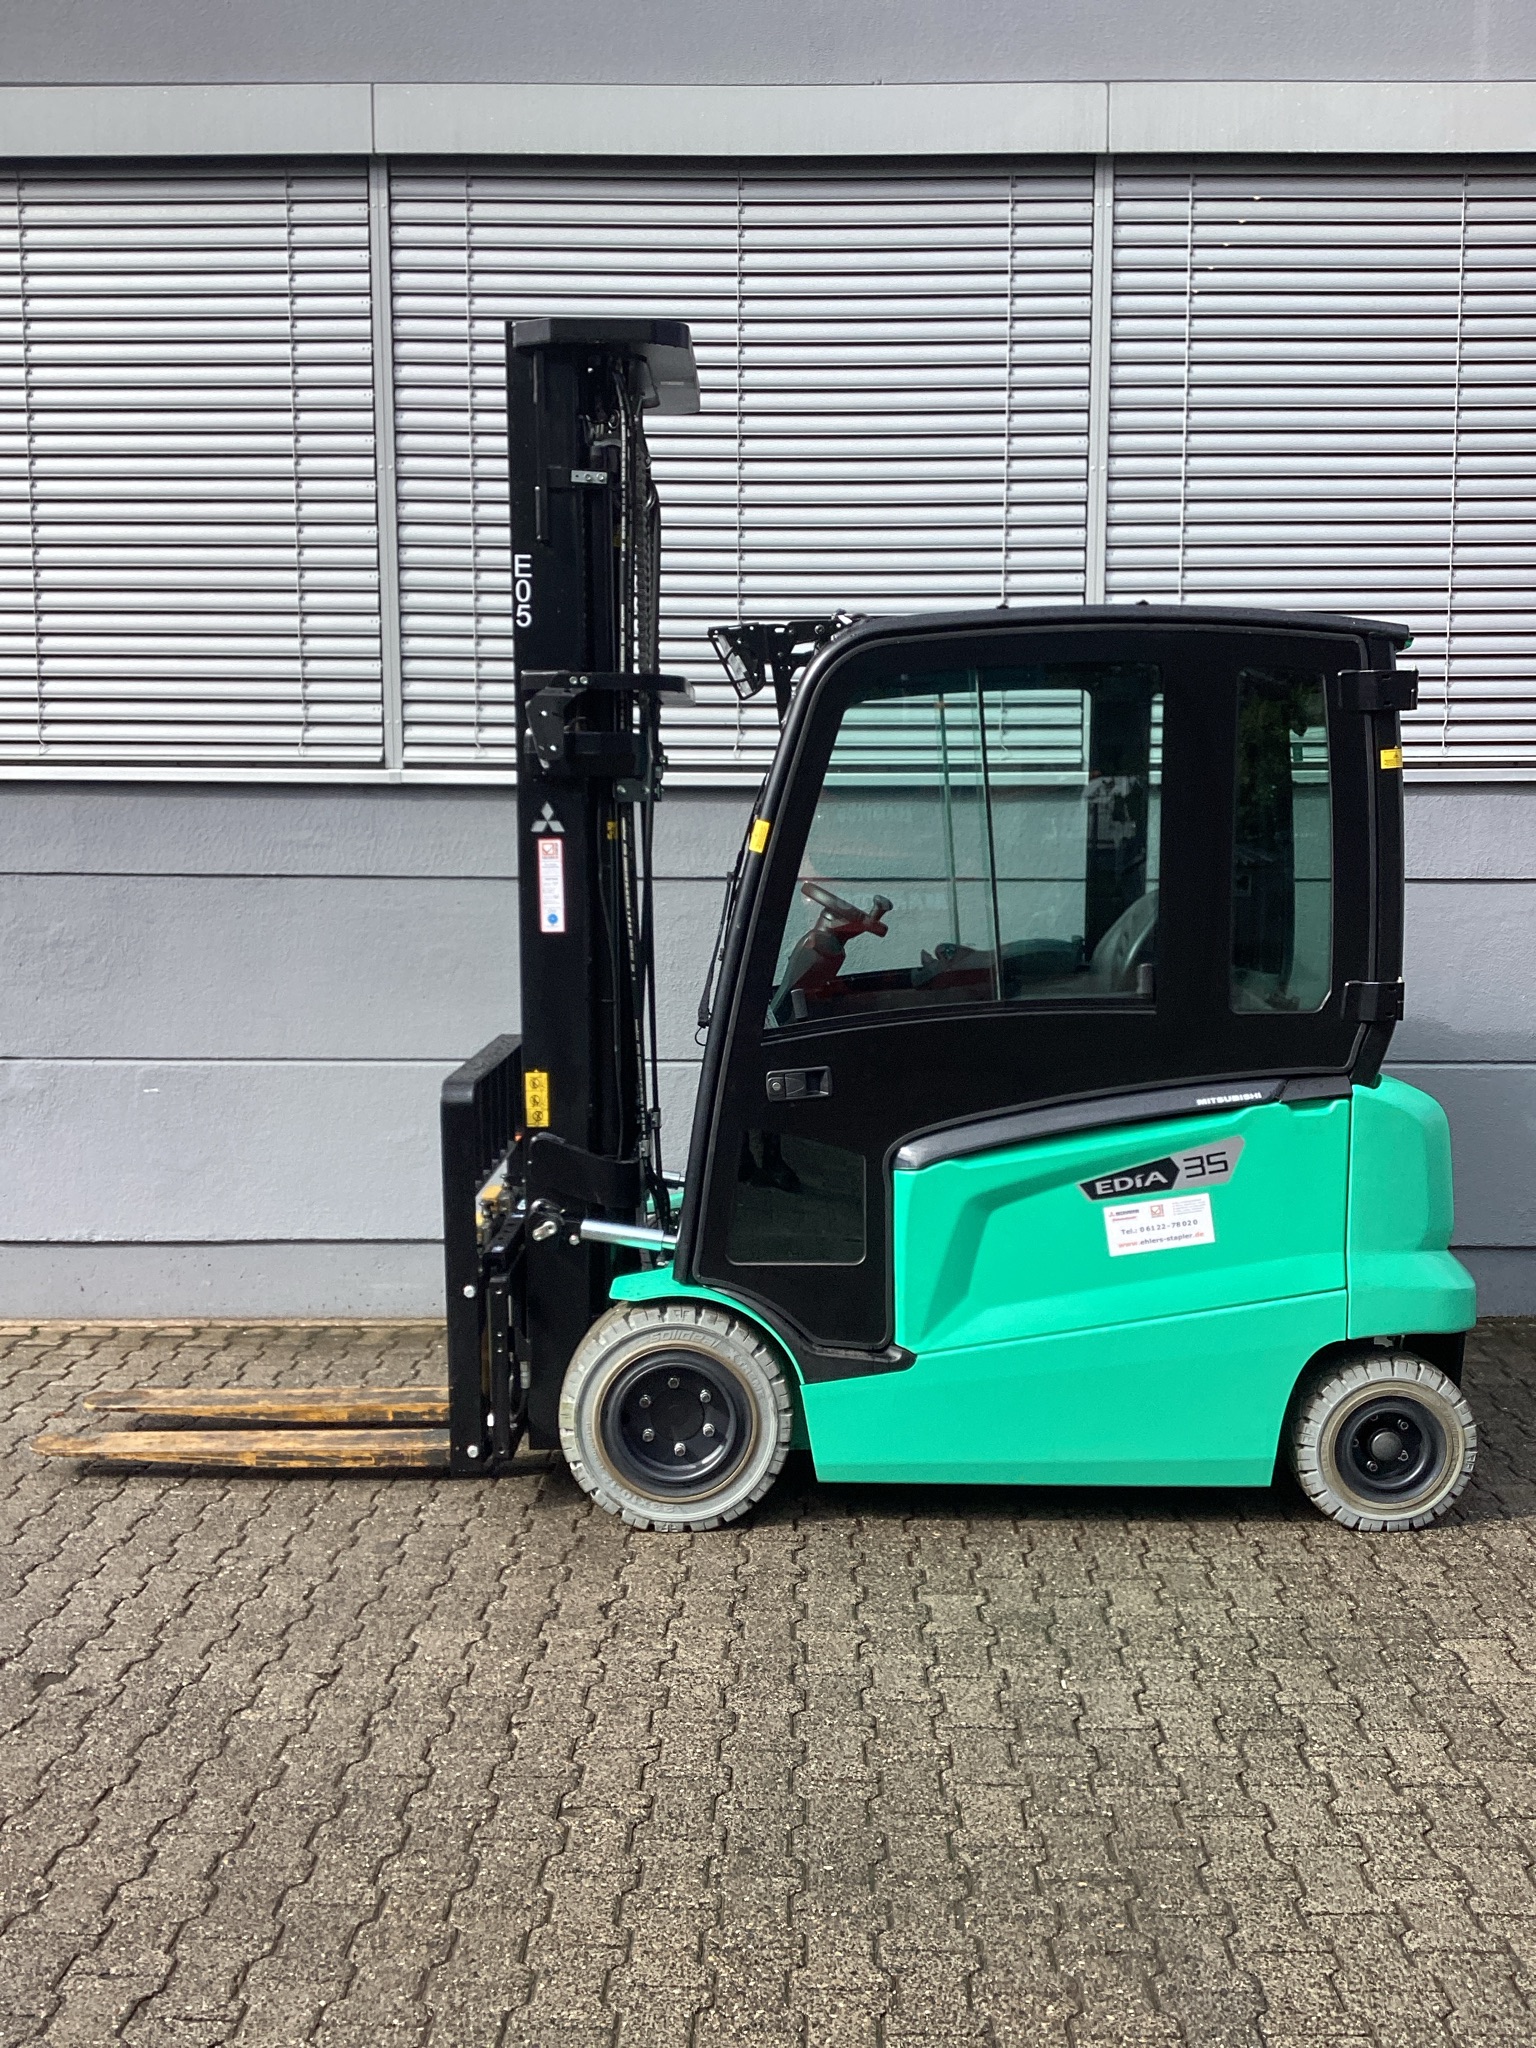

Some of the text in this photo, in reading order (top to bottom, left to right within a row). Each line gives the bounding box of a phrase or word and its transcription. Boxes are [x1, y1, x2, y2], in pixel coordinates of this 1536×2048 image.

[514, 554, 533, 628] E05
[1197, 1092, 1262, 1105] MITSUBISHI
[1183, 1151, 1229, 1179] 35
[1118, 1231, 1205, 1248] www.ehlers-stapler.de
